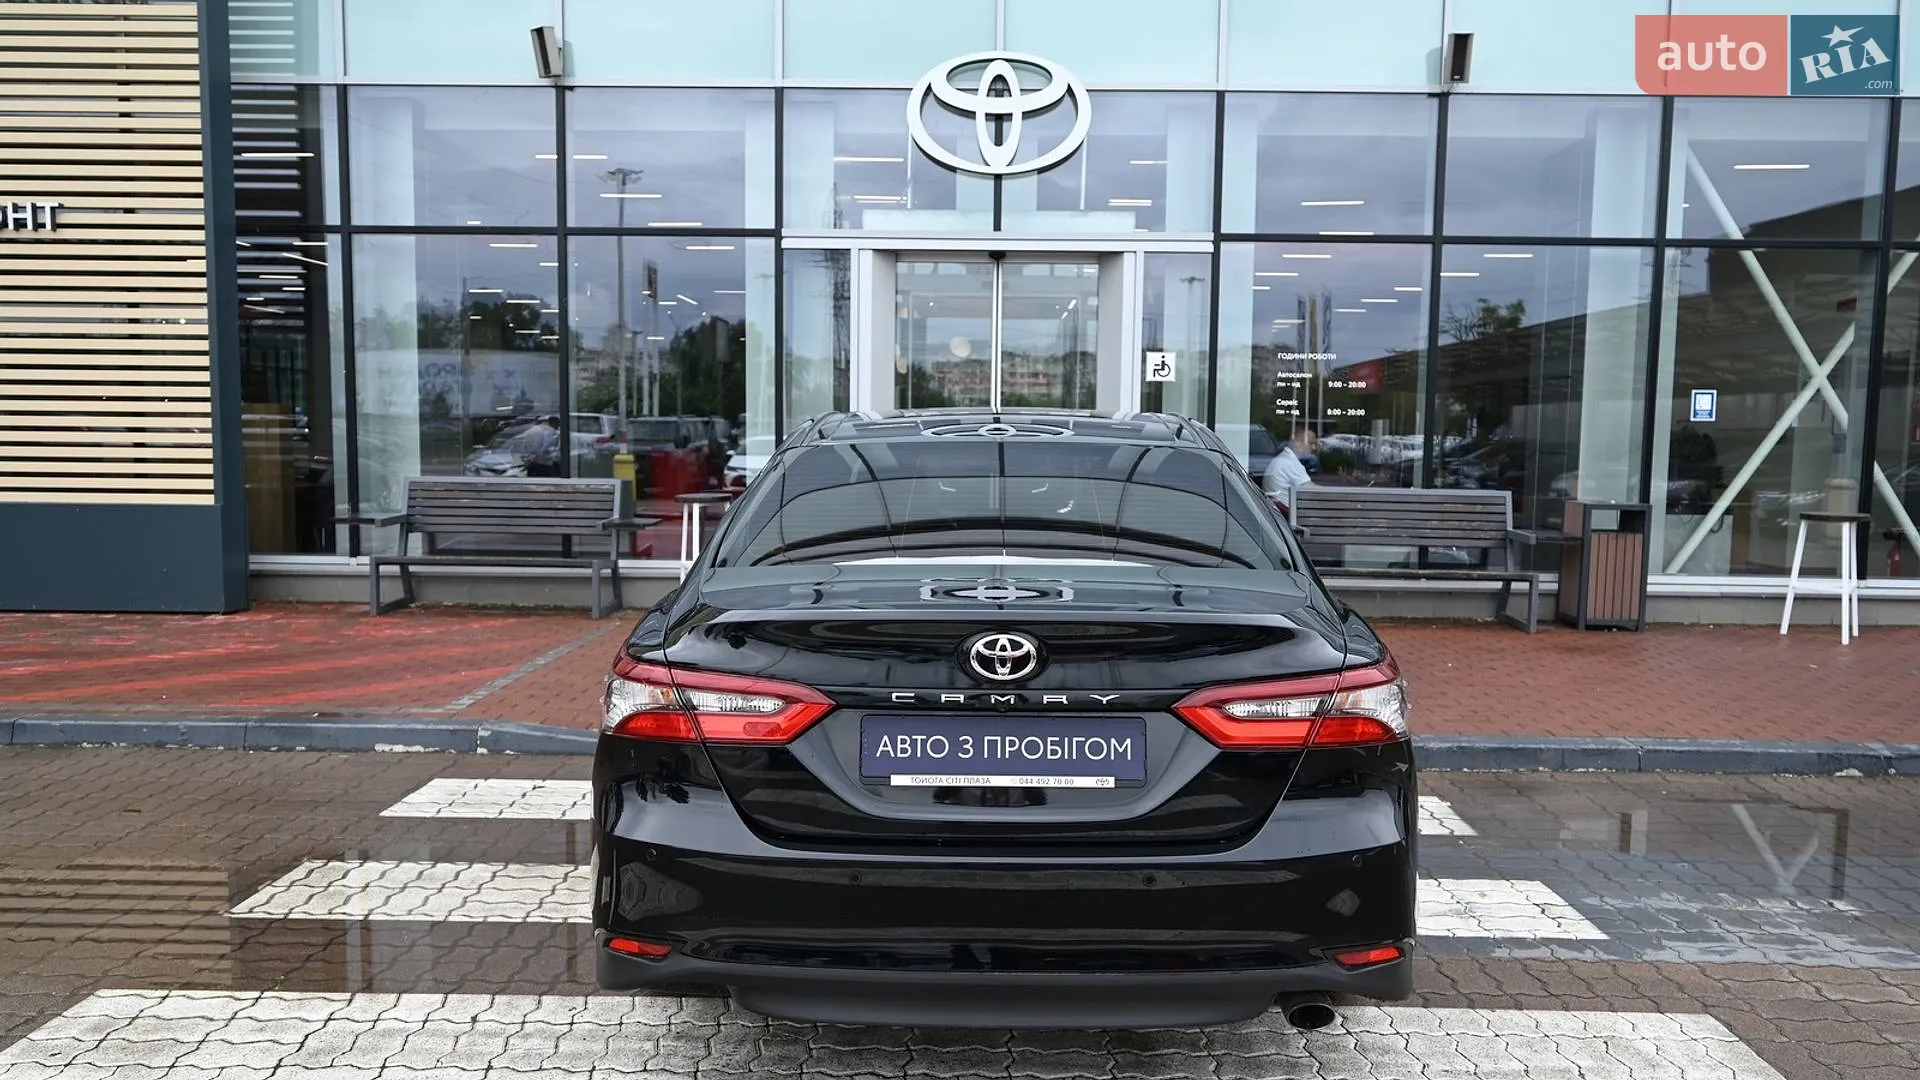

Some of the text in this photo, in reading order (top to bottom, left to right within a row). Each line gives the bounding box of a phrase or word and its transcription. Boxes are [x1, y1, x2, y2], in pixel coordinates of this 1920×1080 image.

[0, 202, 60, 231] НТ
[1278, 352, 1307, 360] ГОДИНИ
[892, 692, 1121, 705] CAMRY
[876, 734, 950, 759] АВТО
[983, 735, 1133, 761] ПРОБІГОМ
